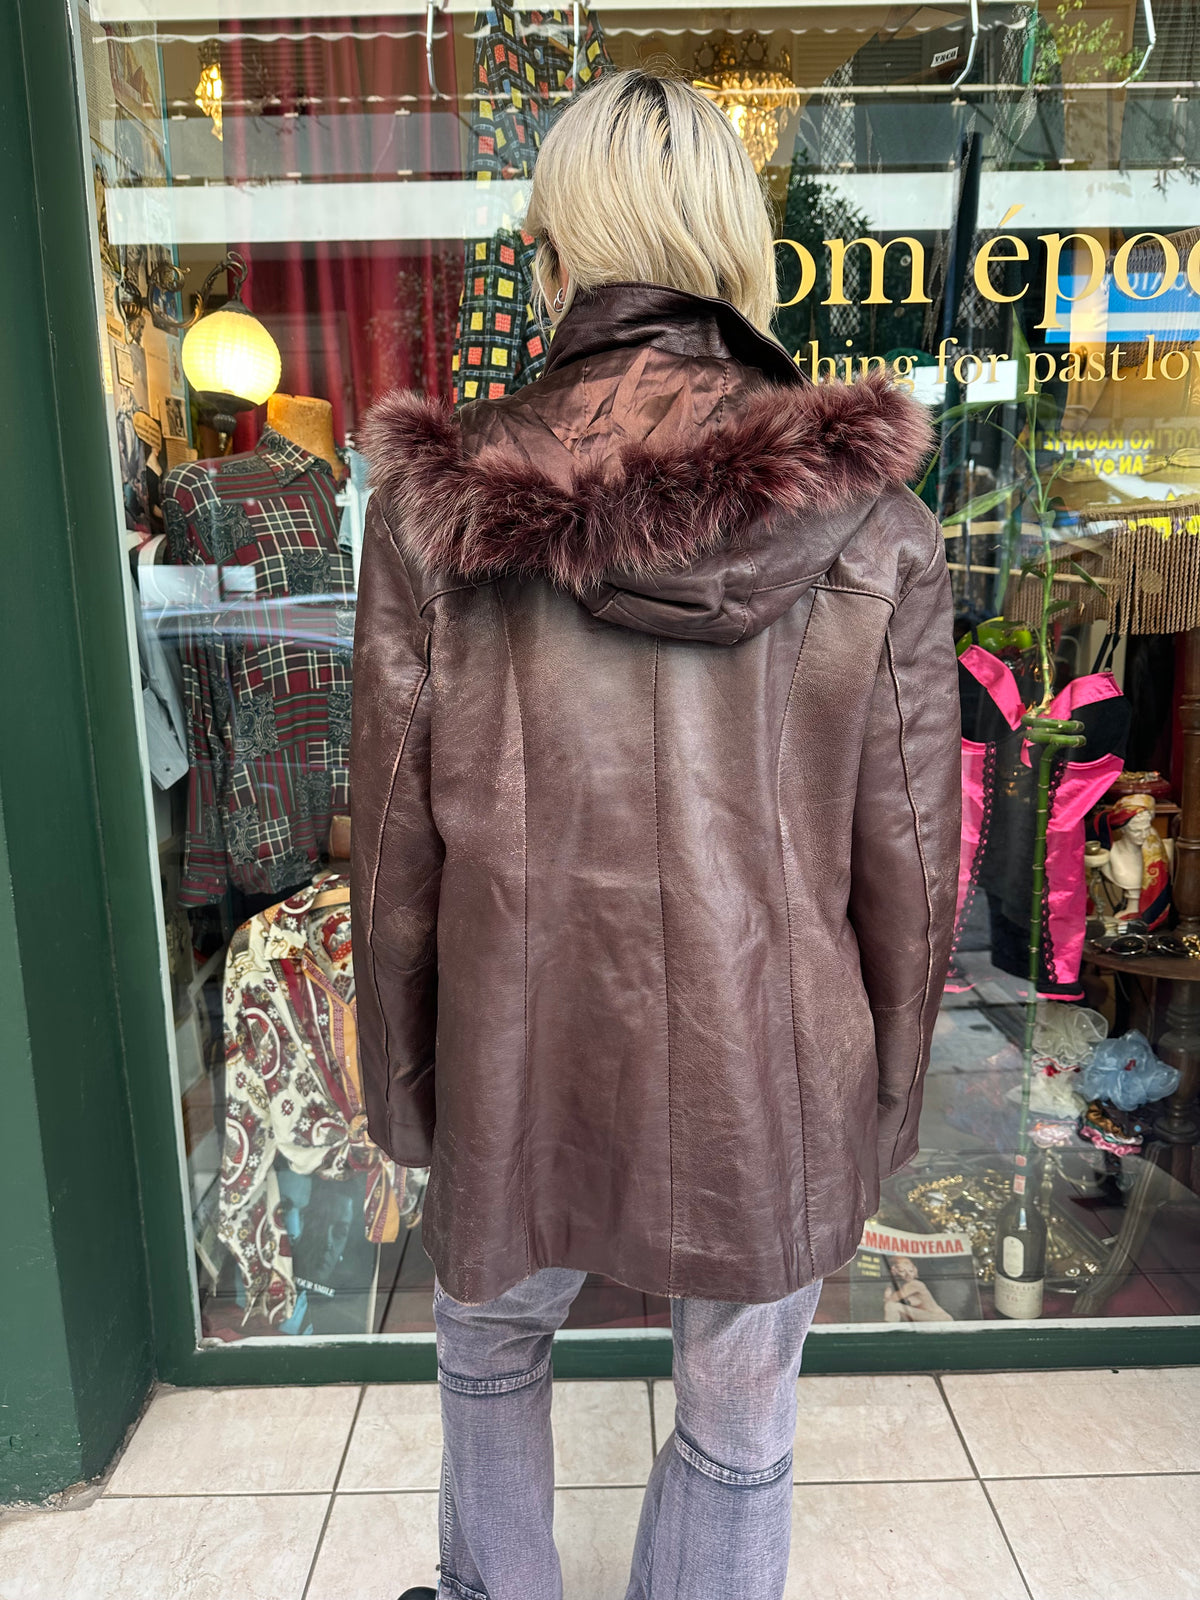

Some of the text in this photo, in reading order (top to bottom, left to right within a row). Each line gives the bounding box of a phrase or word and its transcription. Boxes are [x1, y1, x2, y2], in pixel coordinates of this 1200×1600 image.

[974, 204, 1200, 330] épo
[935, 337, 1009, 384] for
[1024, 343, 1128, 395] past
[861, 1230, 964, 1255] ΜΜΑΝΟΥΕΛΛΑ
